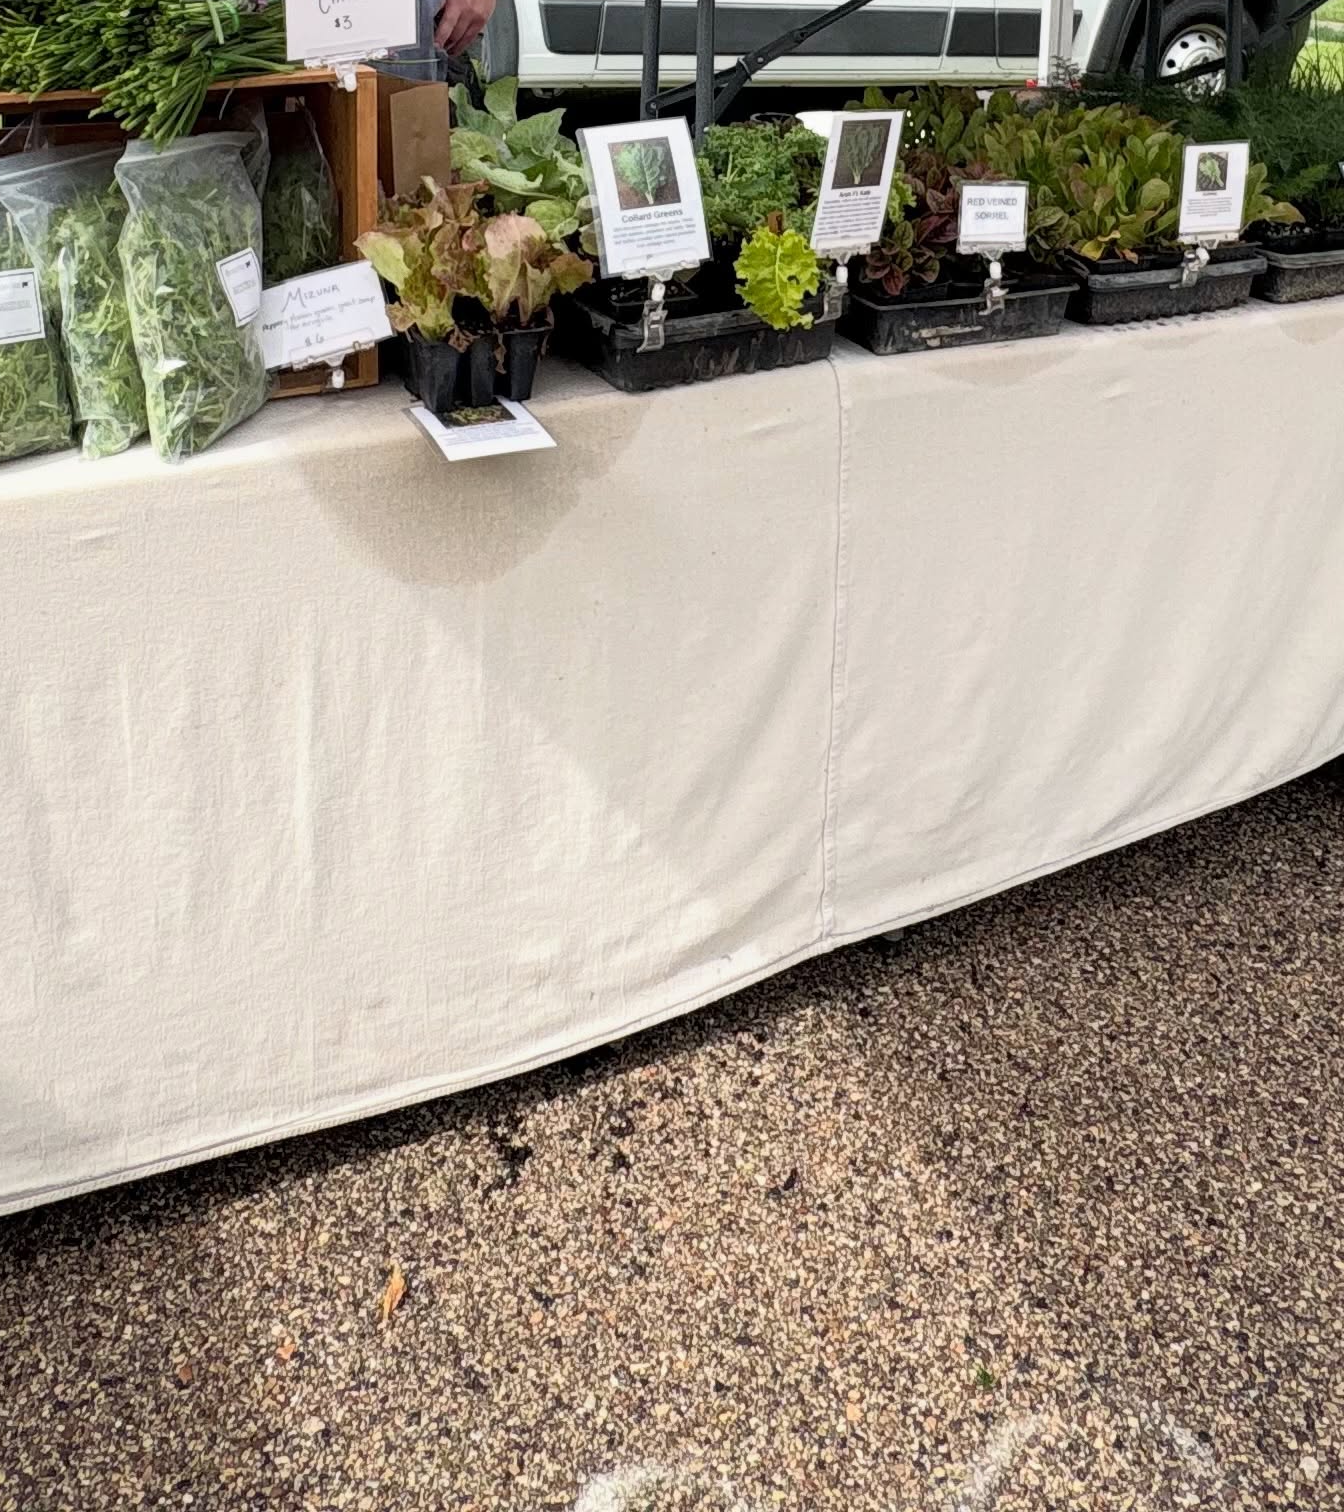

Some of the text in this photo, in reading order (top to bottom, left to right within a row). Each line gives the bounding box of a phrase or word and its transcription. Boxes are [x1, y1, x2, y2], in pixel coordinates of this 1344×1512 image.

[967, 197, 1018, 206] RED VEINED
[621, 208, 684, 224] Collard Greens
[974, 210, 1009, 220] SORREL
